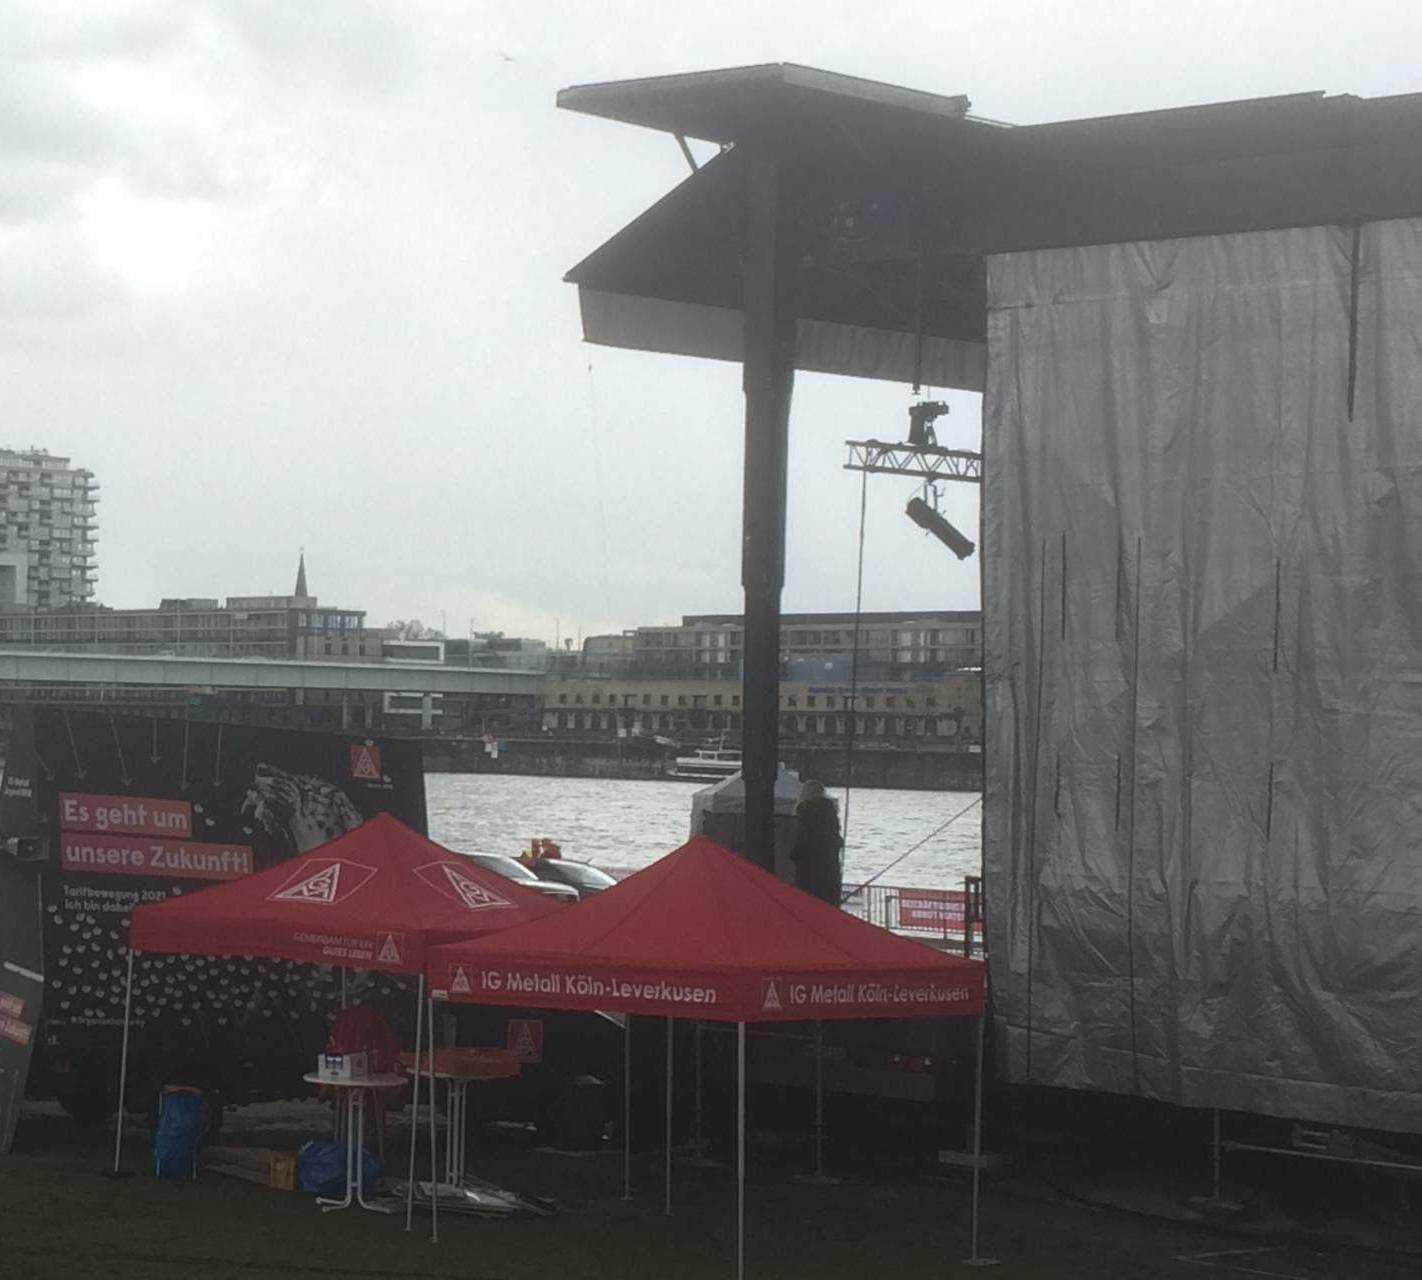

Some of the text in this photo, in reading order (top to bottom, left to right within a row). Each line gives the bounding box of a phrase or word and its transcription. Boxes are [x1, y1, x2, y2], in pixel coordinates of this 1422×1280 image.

[63, 799, 188, 830] Es geht um
[66, 845, 250, 873] unsere Zukunft!
[63, 885, 166, 902] Tarifbewegung 2021
[65, 898, 82, 910] Ich
[83, 899, 100, 911] bin
[481, 971, 717, 1004] IG Metall Köln-Leverkusen
[790, 983, 970, 1004] IG Metall Köln-Leverkusen
